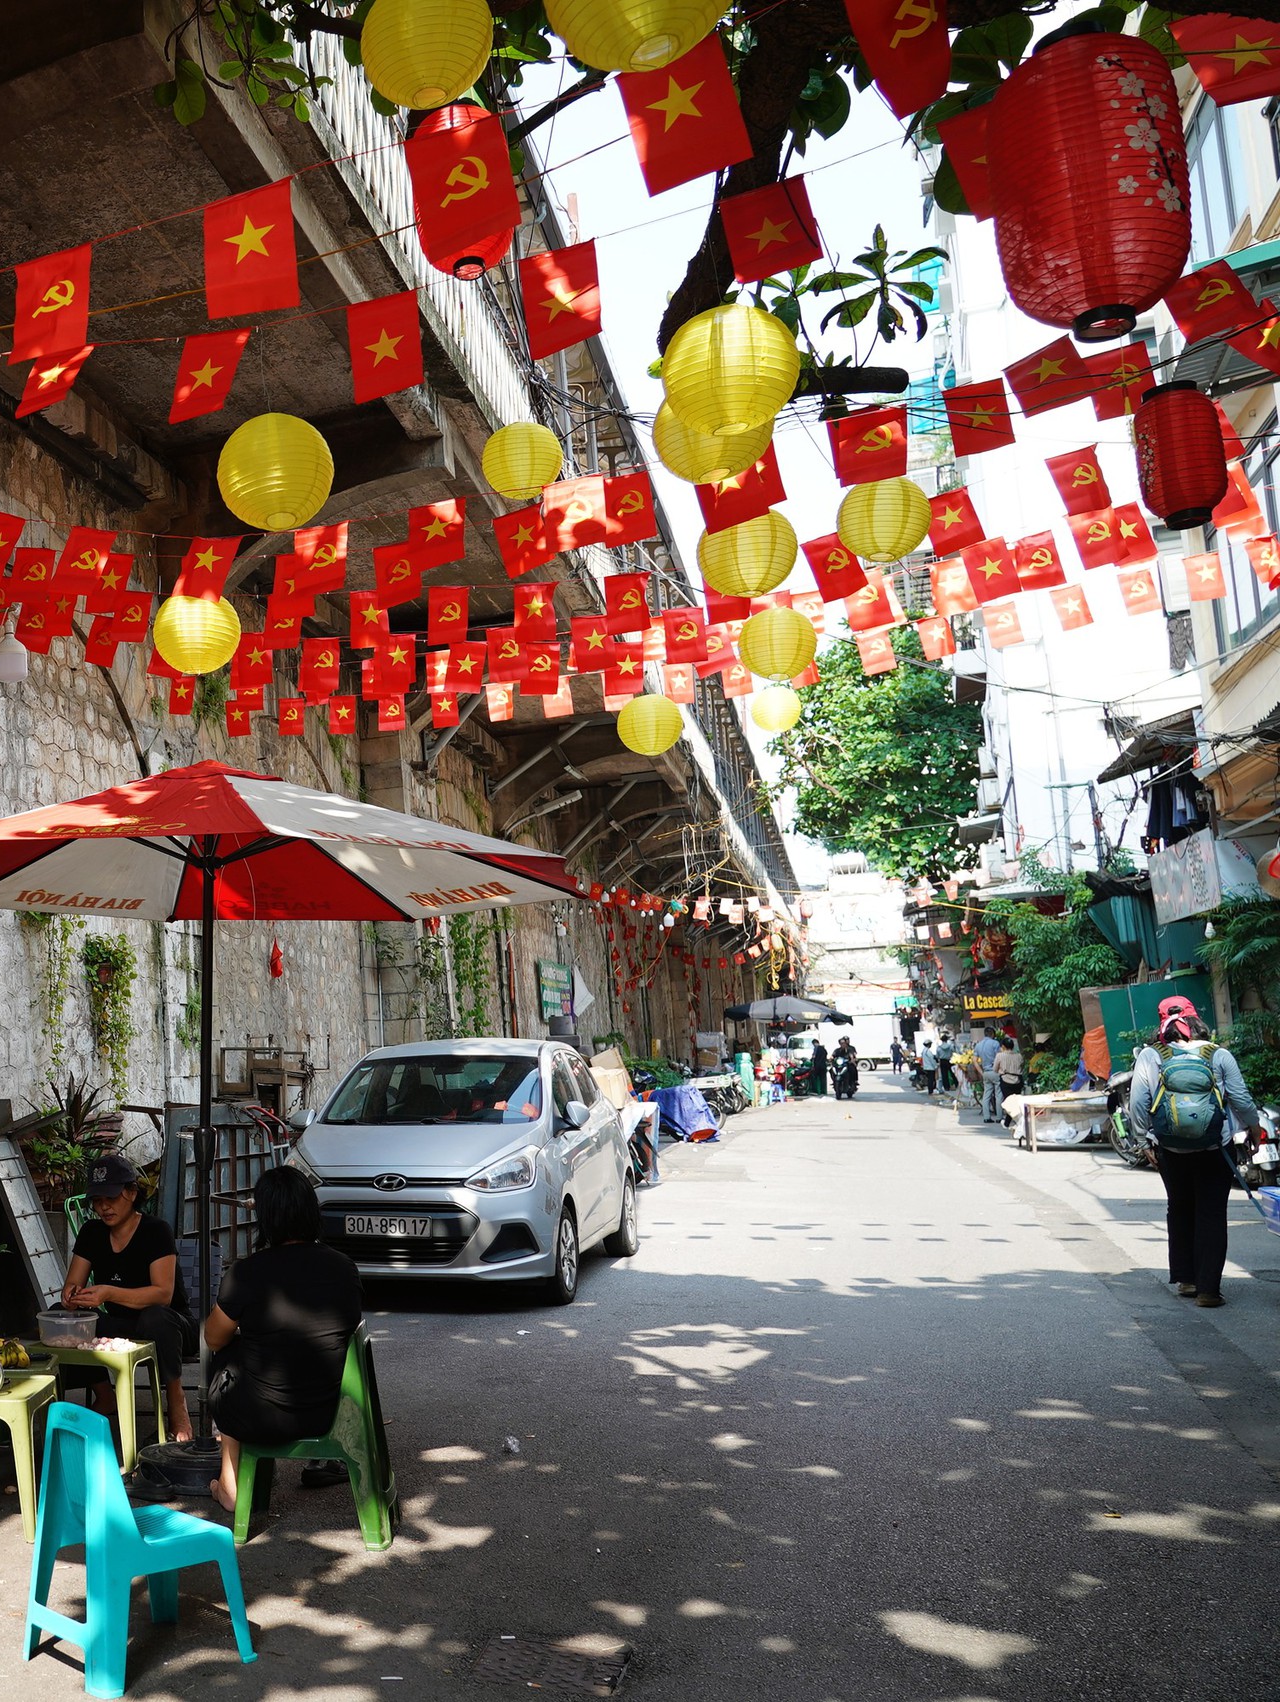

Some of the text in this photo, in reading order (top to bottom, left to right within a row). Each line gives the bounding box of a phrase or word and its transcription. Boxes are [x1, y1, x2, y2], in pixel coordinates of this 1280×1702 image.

[35, 822, 187, 834] HABECO
[963, 995, 976, 1010] La
[347, 1217, 428, 1235] 30A-850.17
